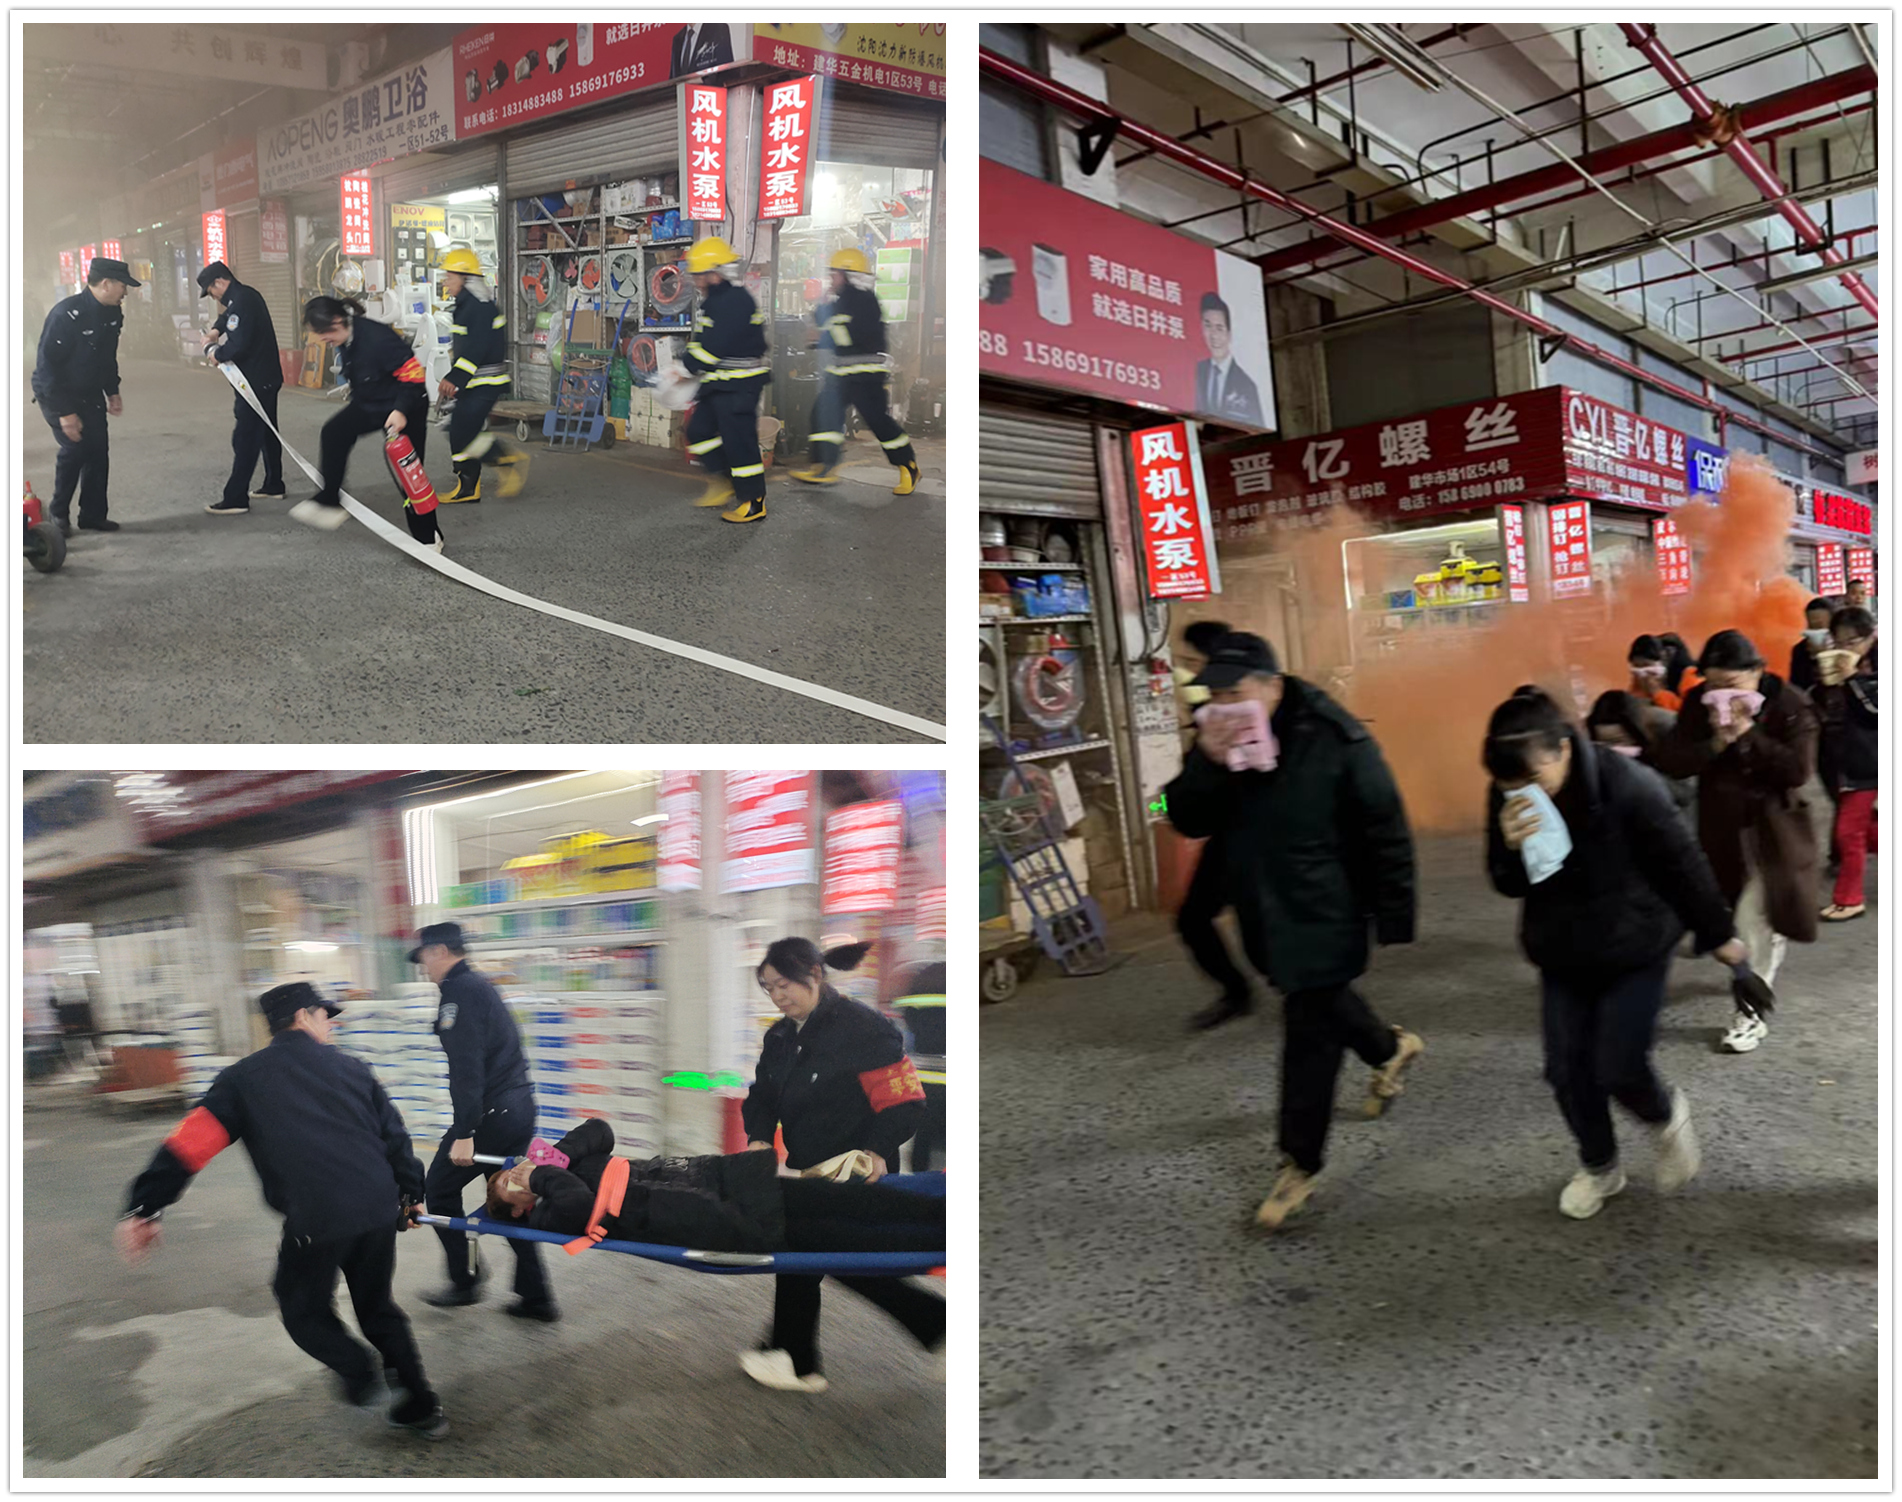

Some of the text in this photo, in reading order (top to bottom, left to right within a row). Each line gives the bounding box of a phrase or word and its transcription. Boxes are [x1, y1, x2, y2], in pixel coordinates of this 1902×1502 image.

[343, 65, 428, 139] 奥鹏卫浴
[502, 88, 563, 119] 18314883488
[569, 62, 645, 99] 15869176933
[813, 54, 923, 93] 建华五金机电1区53号
[691, 89, 722, 199] 风机水泵
[769, 84, 806, 197] 风机水泵
[1088, 254, 1182, 306] 家用高品质
[1092, 292, 1186, 340] 就选日井泵
[1023, 340, 1161, 391] 15869176933
[1230, 403, 1520, 496] 晋亿螺丝
[1408, 458, 1511, 490] 建华市场1区54号
[1141, 431, 1199, 570] 风机水泵
